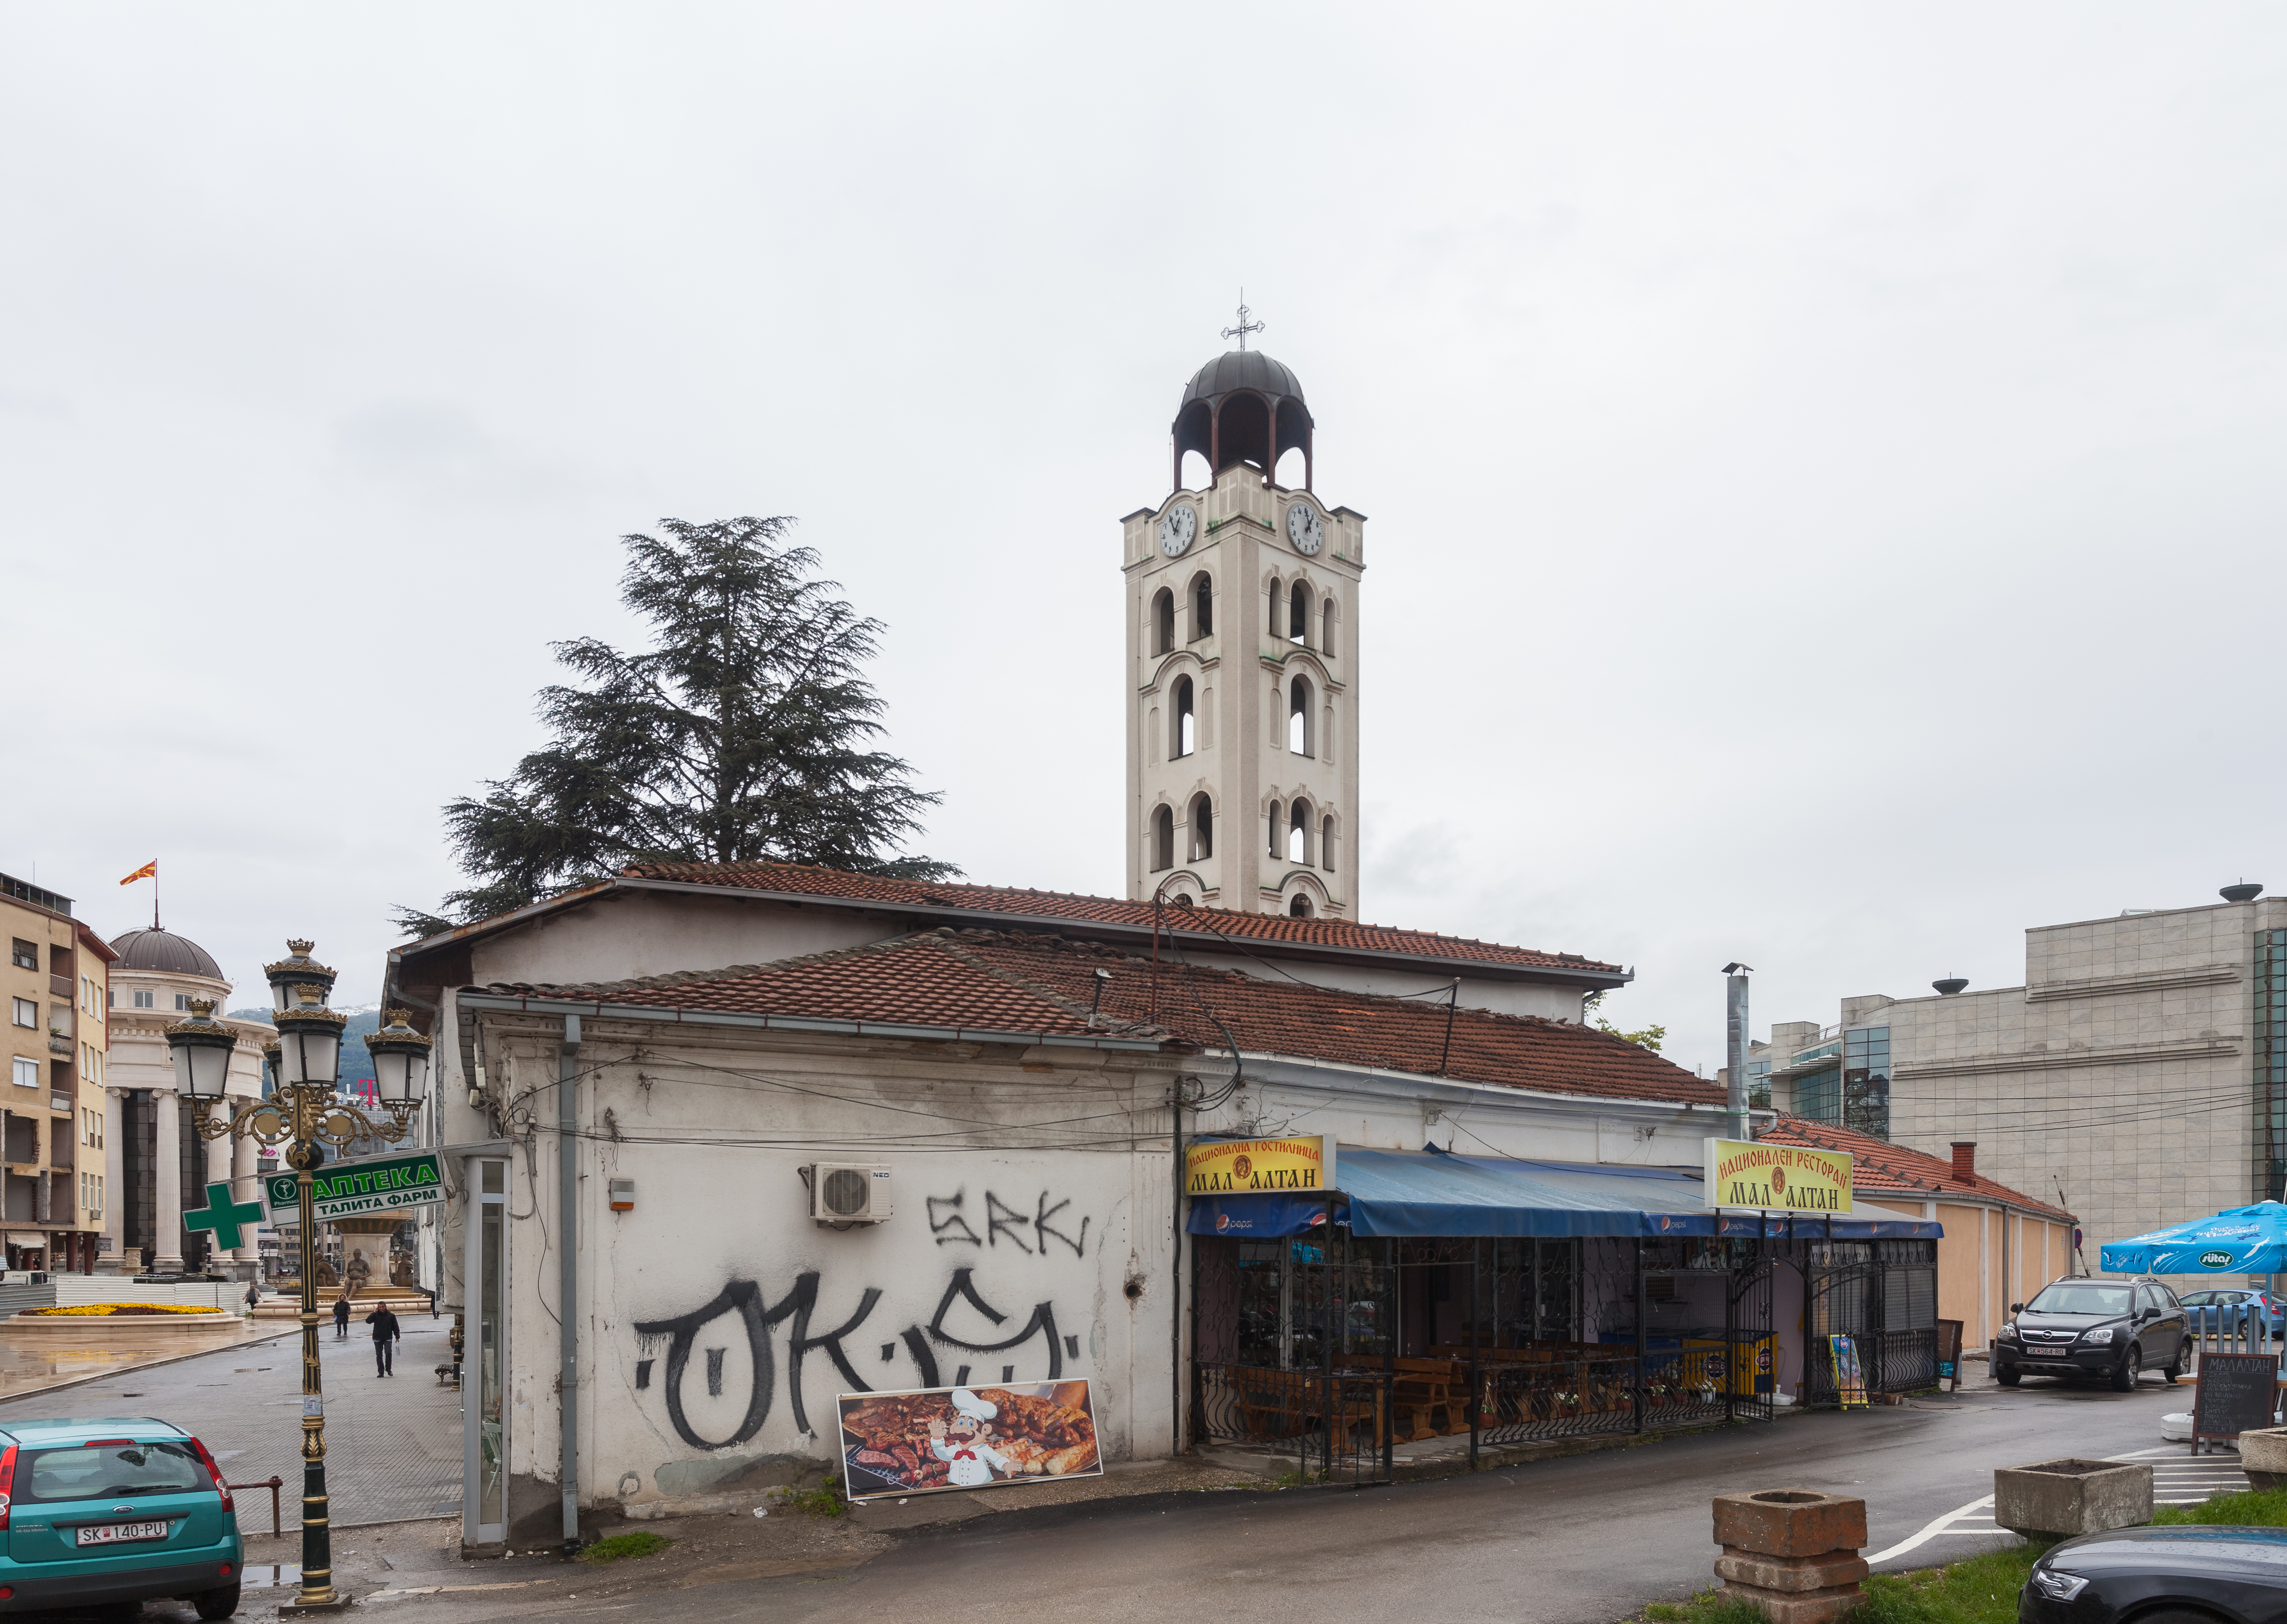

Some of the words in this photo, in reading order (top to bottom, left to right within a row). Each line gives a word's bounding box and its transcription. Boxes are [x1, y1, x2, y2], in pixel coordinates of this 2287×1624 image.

[1189, 1142, 1250, 1168] НАЦИОНАЛНА
[1255, 1141, 1319, 1162] ГОСТИЛНИЦА
[1191, 1172, 1234, 1191] МАЛ
[1250, 1169, 1316, 1189] АЛТАН
[1719, 1149, 1792, 1180] НАЦИОНАЛЕН
[1797, 1152, 1847, 1189] РЕСТОРАН
[313, 1164, 439, 1200] АПТЕКА
[319, 1197, 384, 1215] ТАЛИТА
[387, 1189, 437, 1206] ФАРМ
[1730, 1182, 1772, 1206] МАЛ
[1786, 1186, 1838, 1209] АЛТАН
[1230, 1219, 1253, 1229] pepsi
[1671, 1220, 1686, 1229] pepsi
[1730, 1222, 1744, 1231] pepsi
[2202, 1253, 2230, 1265] sütaş
[83, 1528, 101, 1542] SK
[114, 1523, 162, 1538] 140-PU
